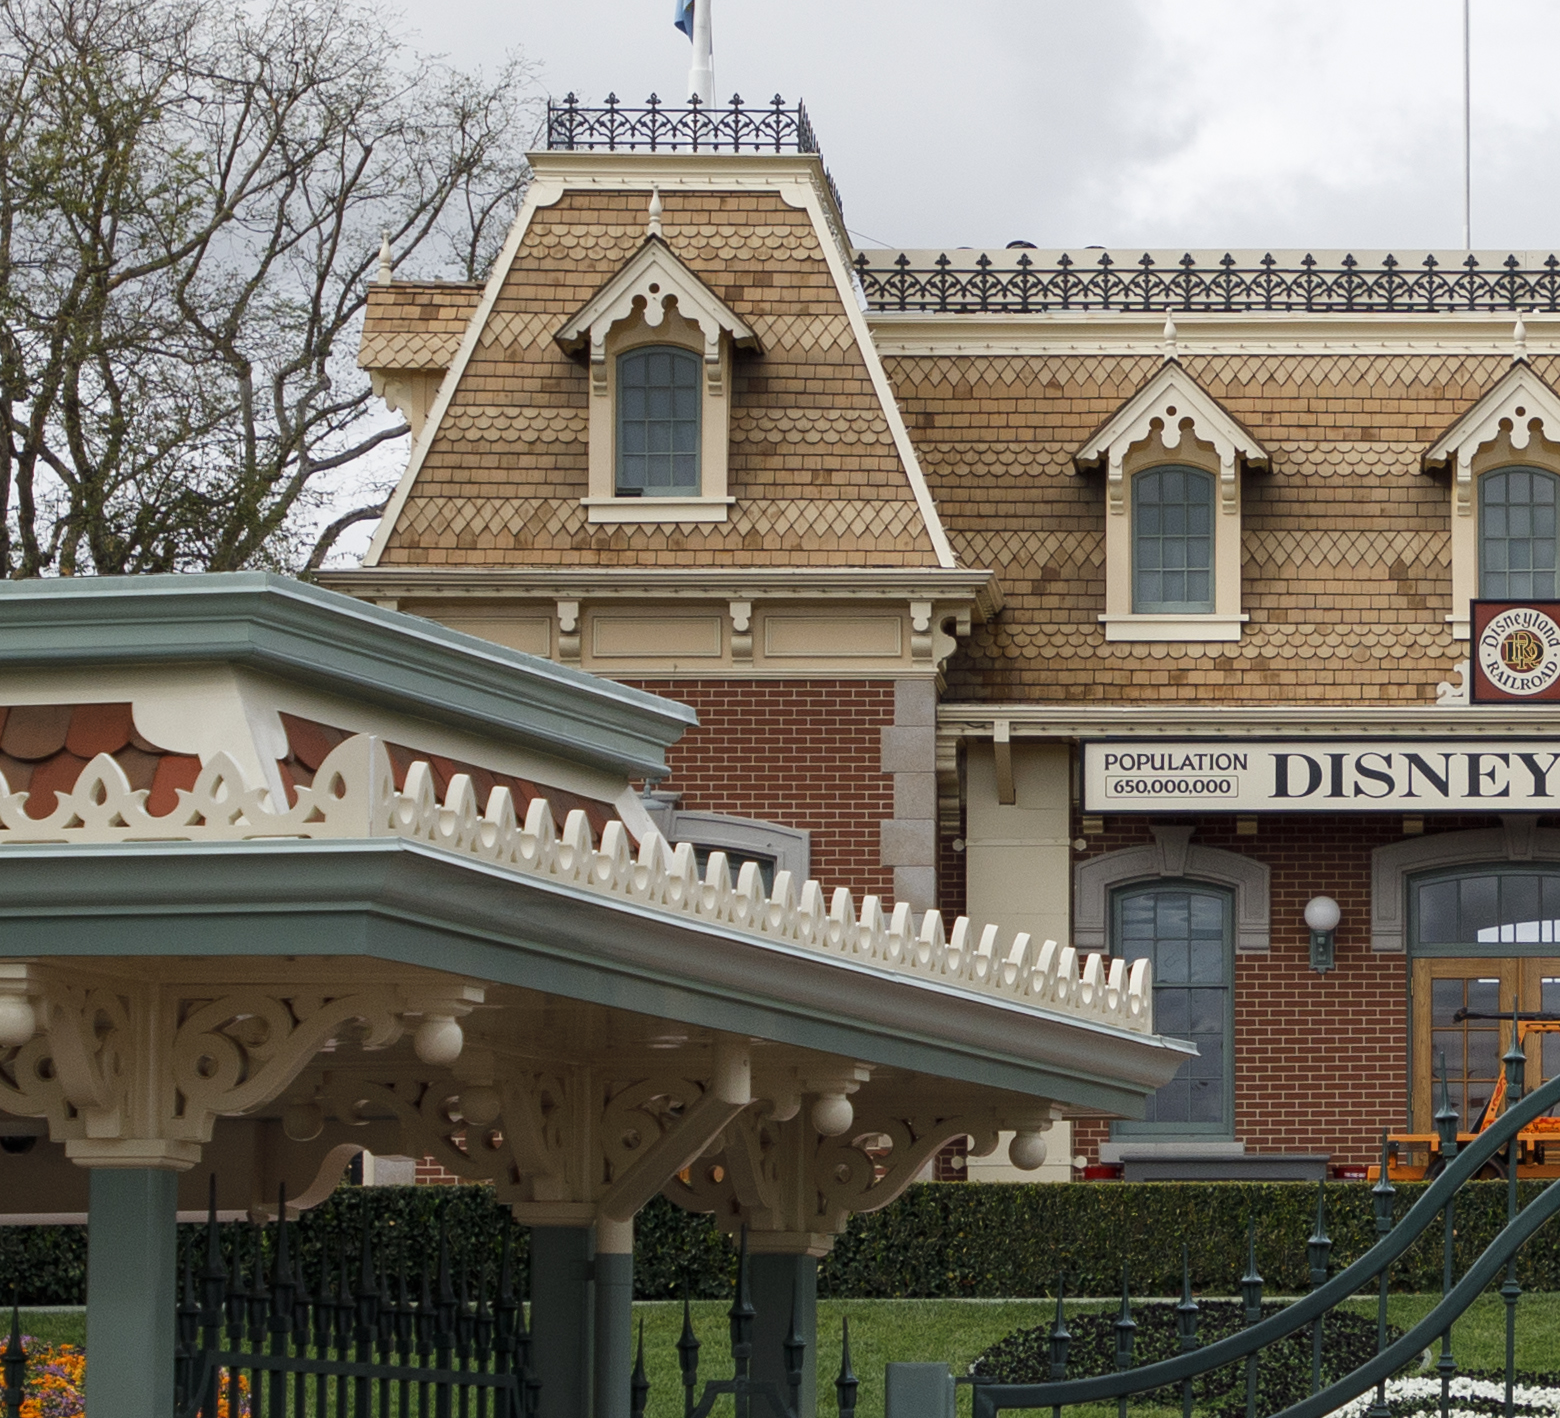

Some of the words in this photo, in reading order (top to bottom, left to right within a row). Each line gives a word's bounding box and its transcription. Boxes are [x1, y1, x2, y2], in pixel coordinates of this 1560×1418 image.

[1486, 659, 1558, 690] RAILROAD
[1104, 753, 1248, 771] POPULATION
[1113, 779, 1231, 795] 650,000,000
